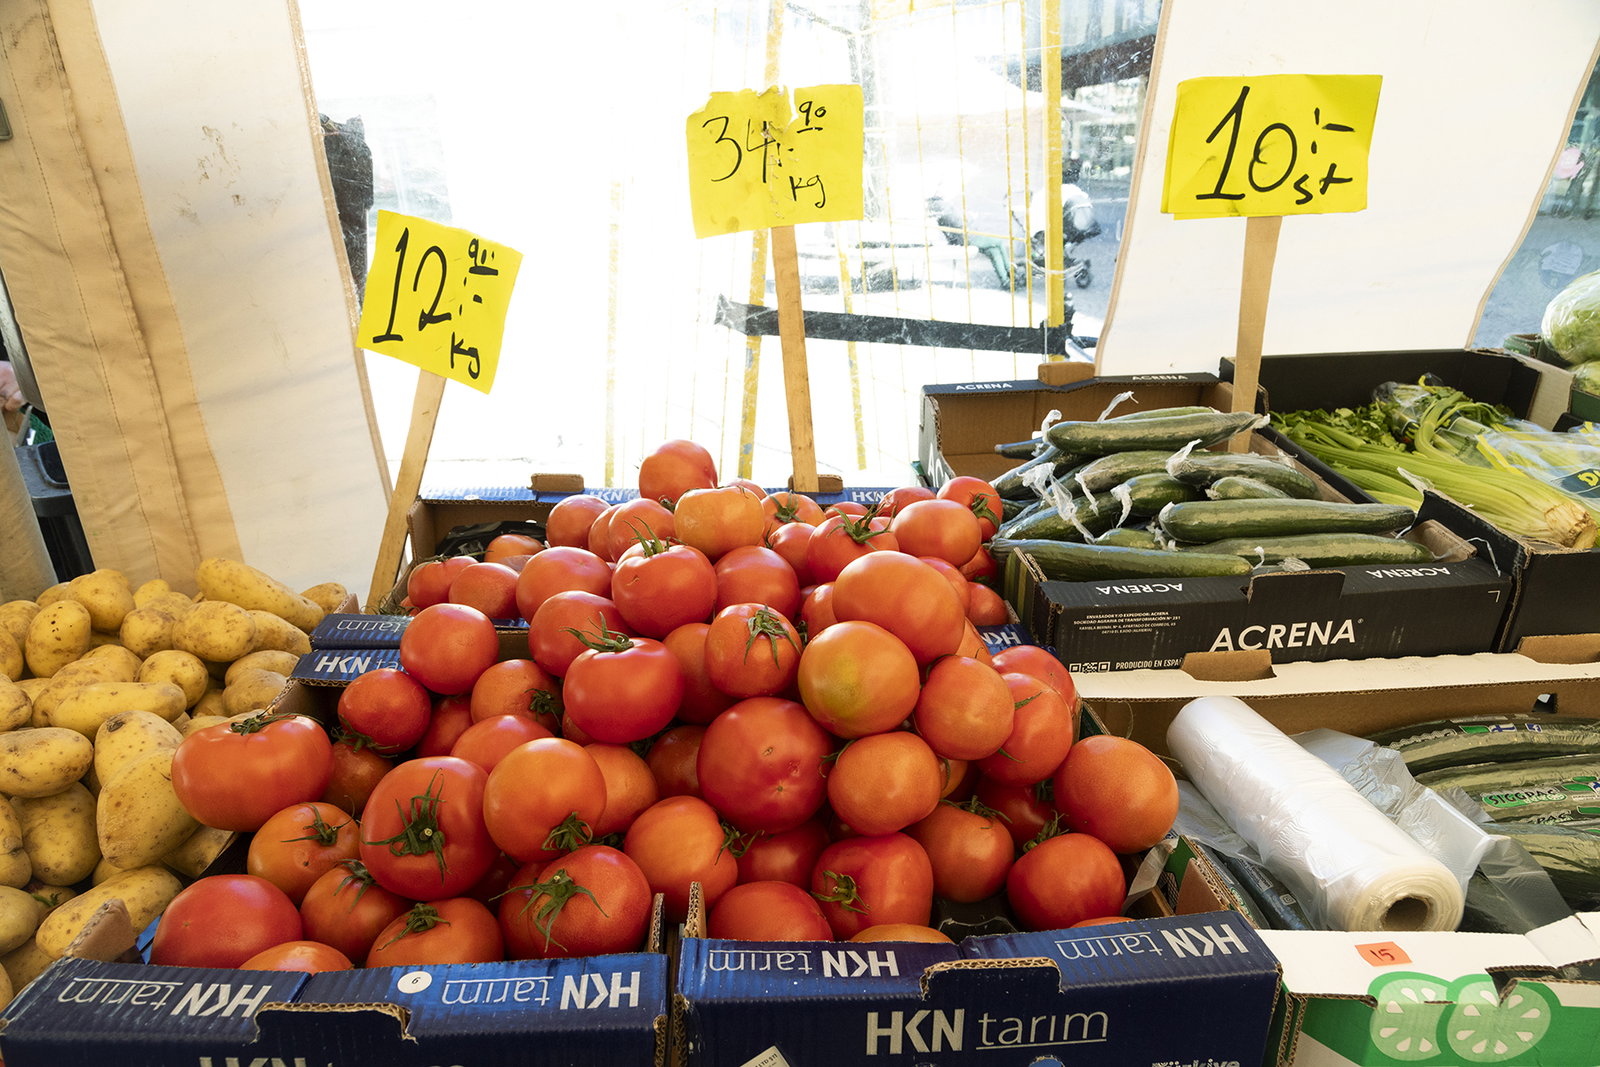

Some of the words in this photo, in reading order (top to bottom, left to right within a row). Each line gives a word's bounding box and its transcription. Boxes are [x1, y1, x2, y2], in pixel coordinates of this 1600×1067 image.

[955, 382, 1013, 391] ACRENA
[1366, 566, 1451, 579] ACRENA
[1095, 583, 1184, 595] ACRENA
[1208, 618, 1357, 653] ACRENA
[314, 655, 371, 674] HKN
[1115, 660, 1152, 670] PRODUCIDO
[1154, 660, 1162, 668] EN
[1160, 923, 1250, 959] HKN
[821, 949, 900, 978] HKN
[1369, 948, 1396, 962] 15
[170, 983, 272, 1018] HKN
[559, 971, 641, 1011] HKN
[865, 1009, 965, 1056] HKN
